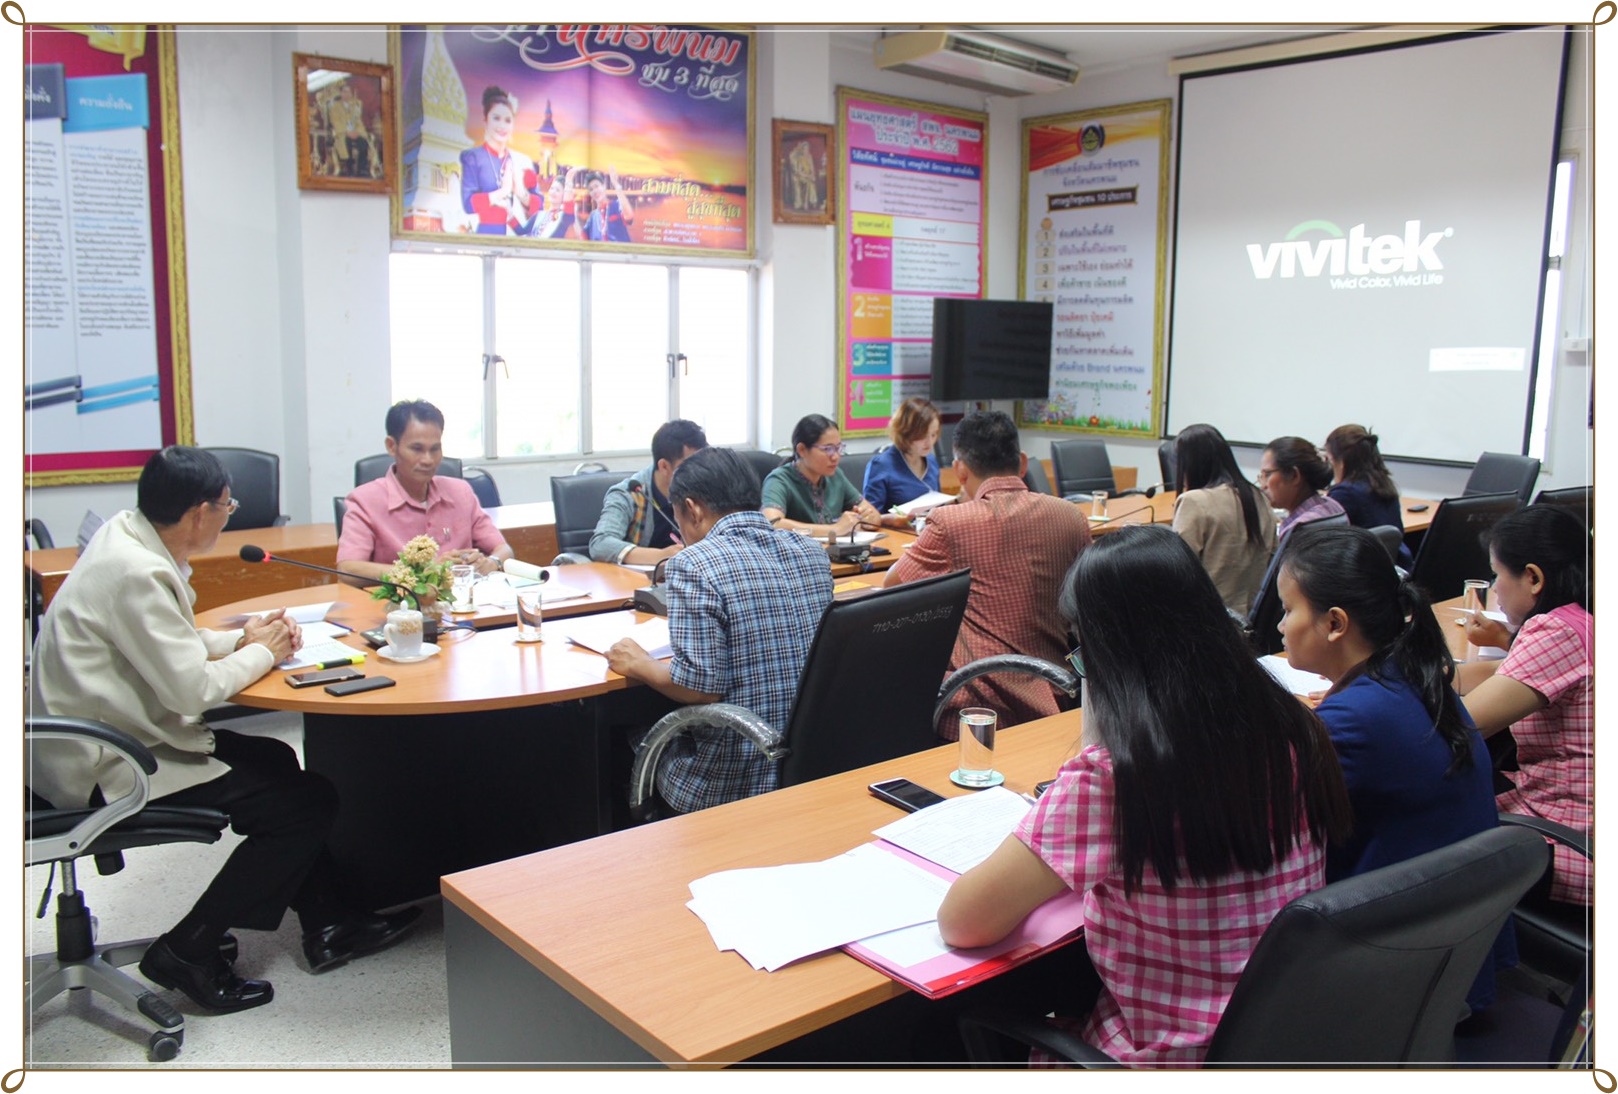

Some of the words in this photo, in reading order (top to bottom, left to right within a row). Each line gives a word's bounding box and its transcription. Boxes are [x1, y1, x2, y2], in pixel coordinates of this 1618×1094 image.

[674, 65, 690, 86] 3
[1246, 219, 1445, 280] vivitek
[1330, 278, 1357, 290] Vivid
[1358, 277, 1391, 289] Color,
[1393, 275, 1421, 288] Vivid
[1423, 274, 1444, 285] Life
[854, 295, 866, 318] 2
[853, 343, 865, 366] 3
